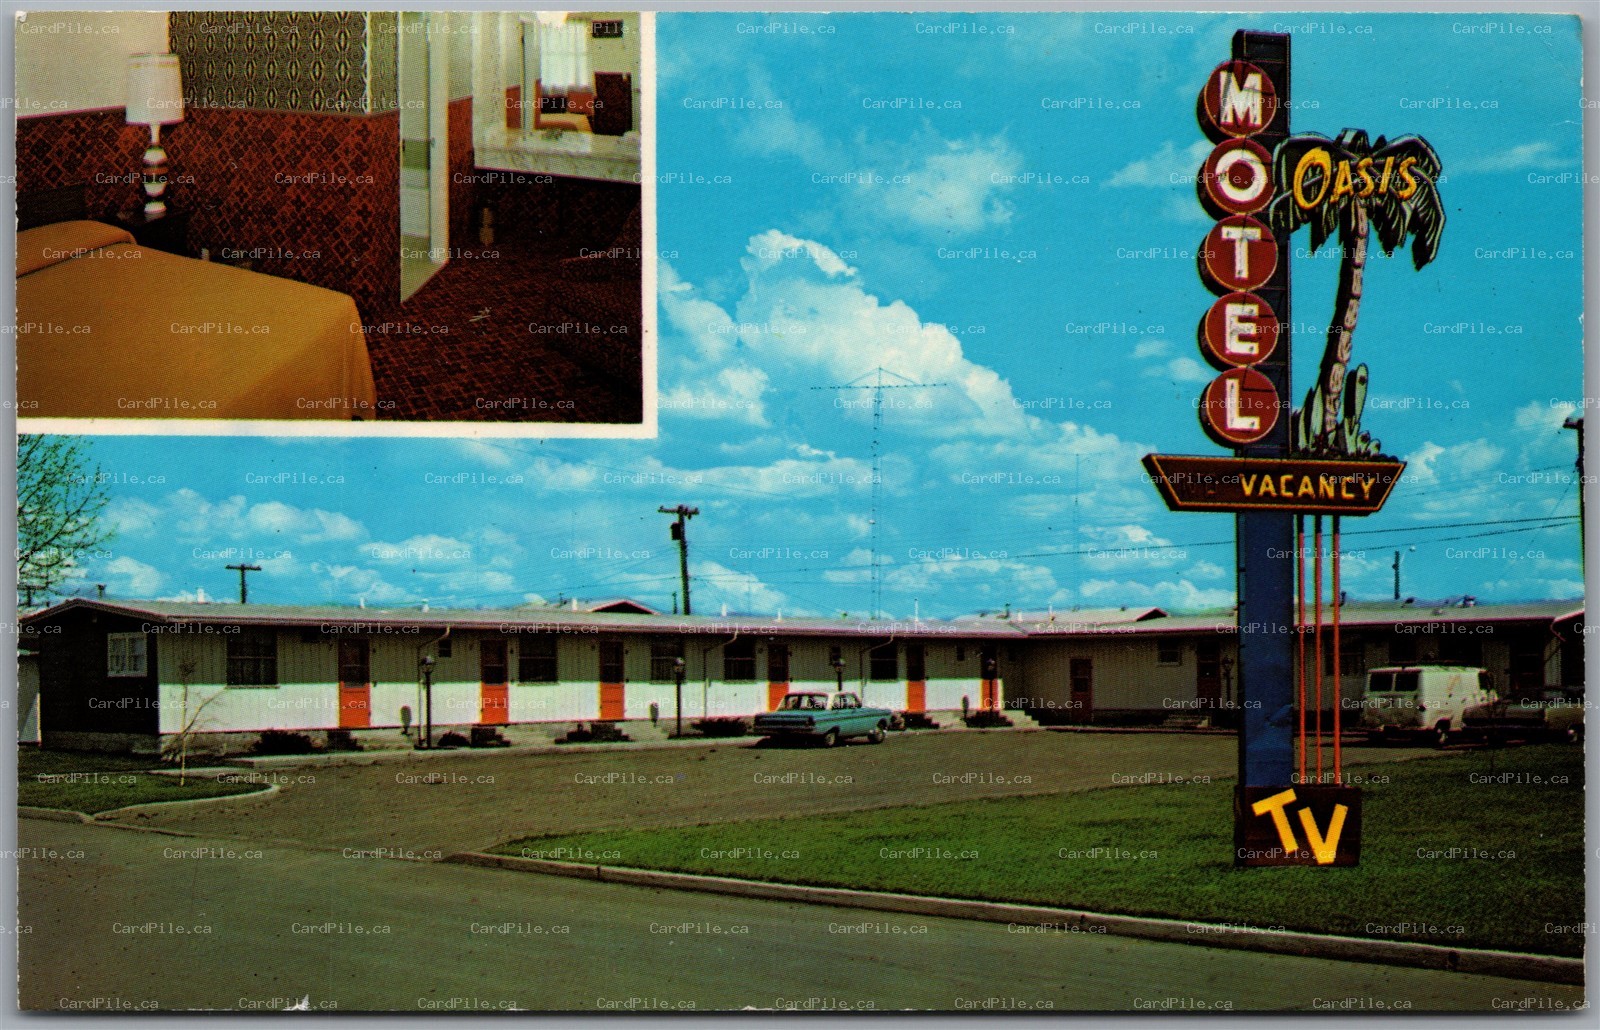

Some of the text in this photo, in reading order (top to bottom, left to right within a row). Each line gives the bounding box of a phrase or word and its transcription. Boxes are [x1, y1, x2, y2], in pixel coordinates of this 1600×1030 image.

[1215, 70, 1267, 431] MOTEL
[1240, 473, 1376, 500] VACANCY
[1251, 788, 1348, 865] TV
